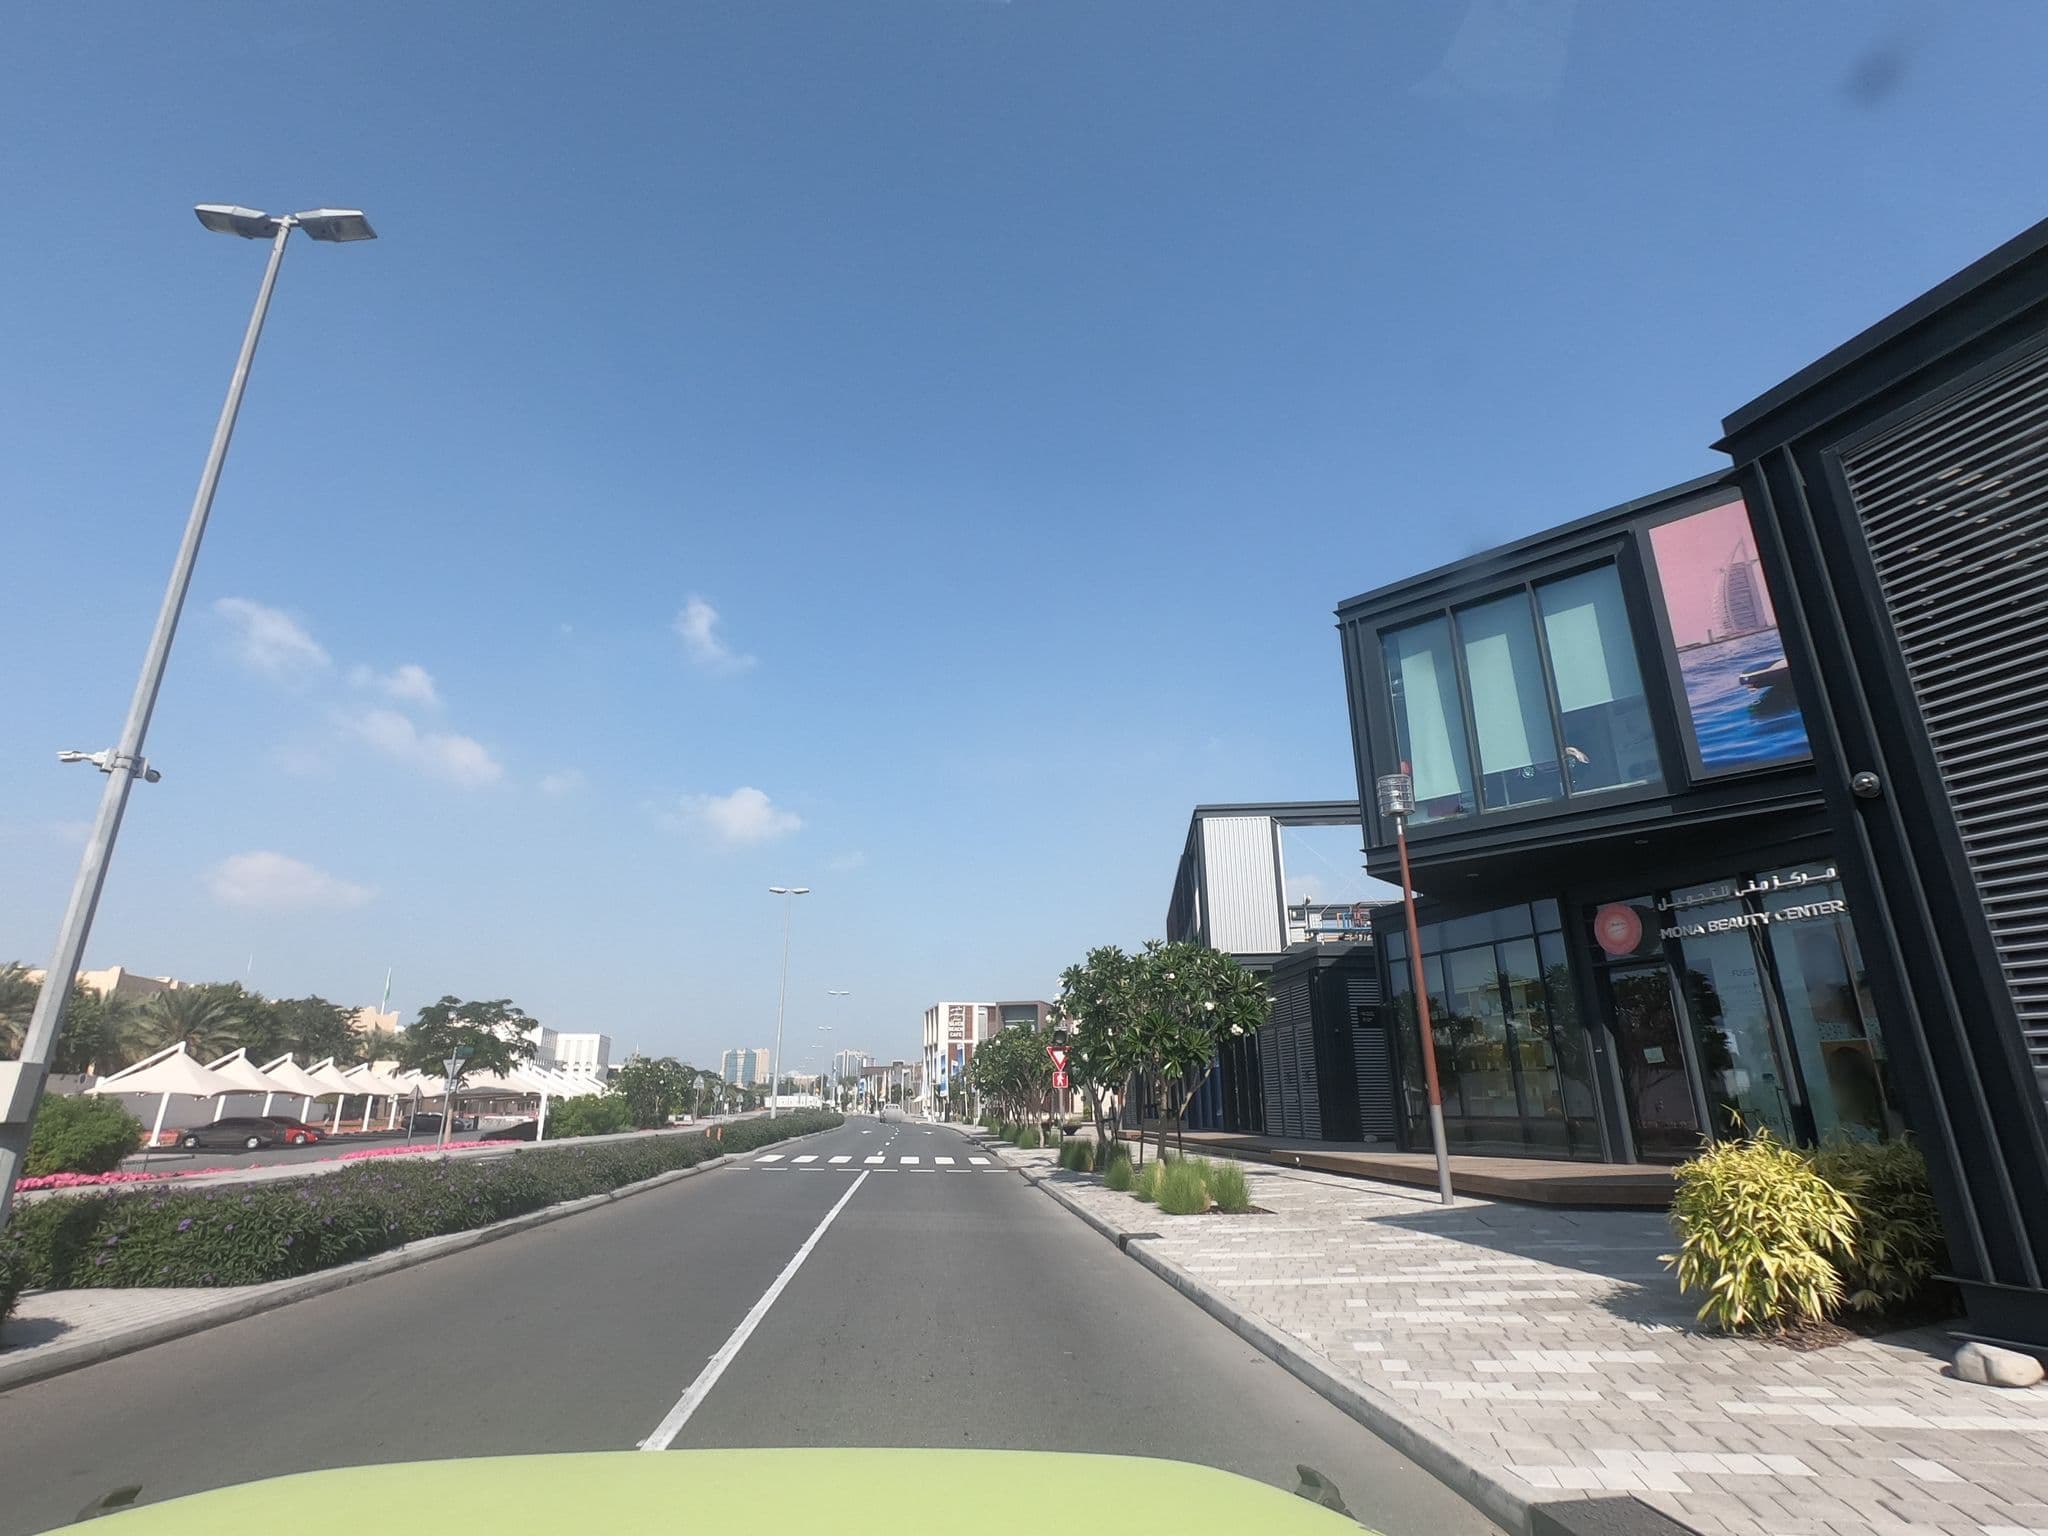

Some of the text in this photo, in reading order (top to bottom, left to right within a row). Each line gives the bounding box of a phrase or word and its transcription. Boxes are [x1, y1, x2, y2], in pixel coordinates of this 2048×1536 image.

[1773, 867, 1836, 889] مركز
[1660, 899, 1847, 939] MONA BEAUTY CENTER
